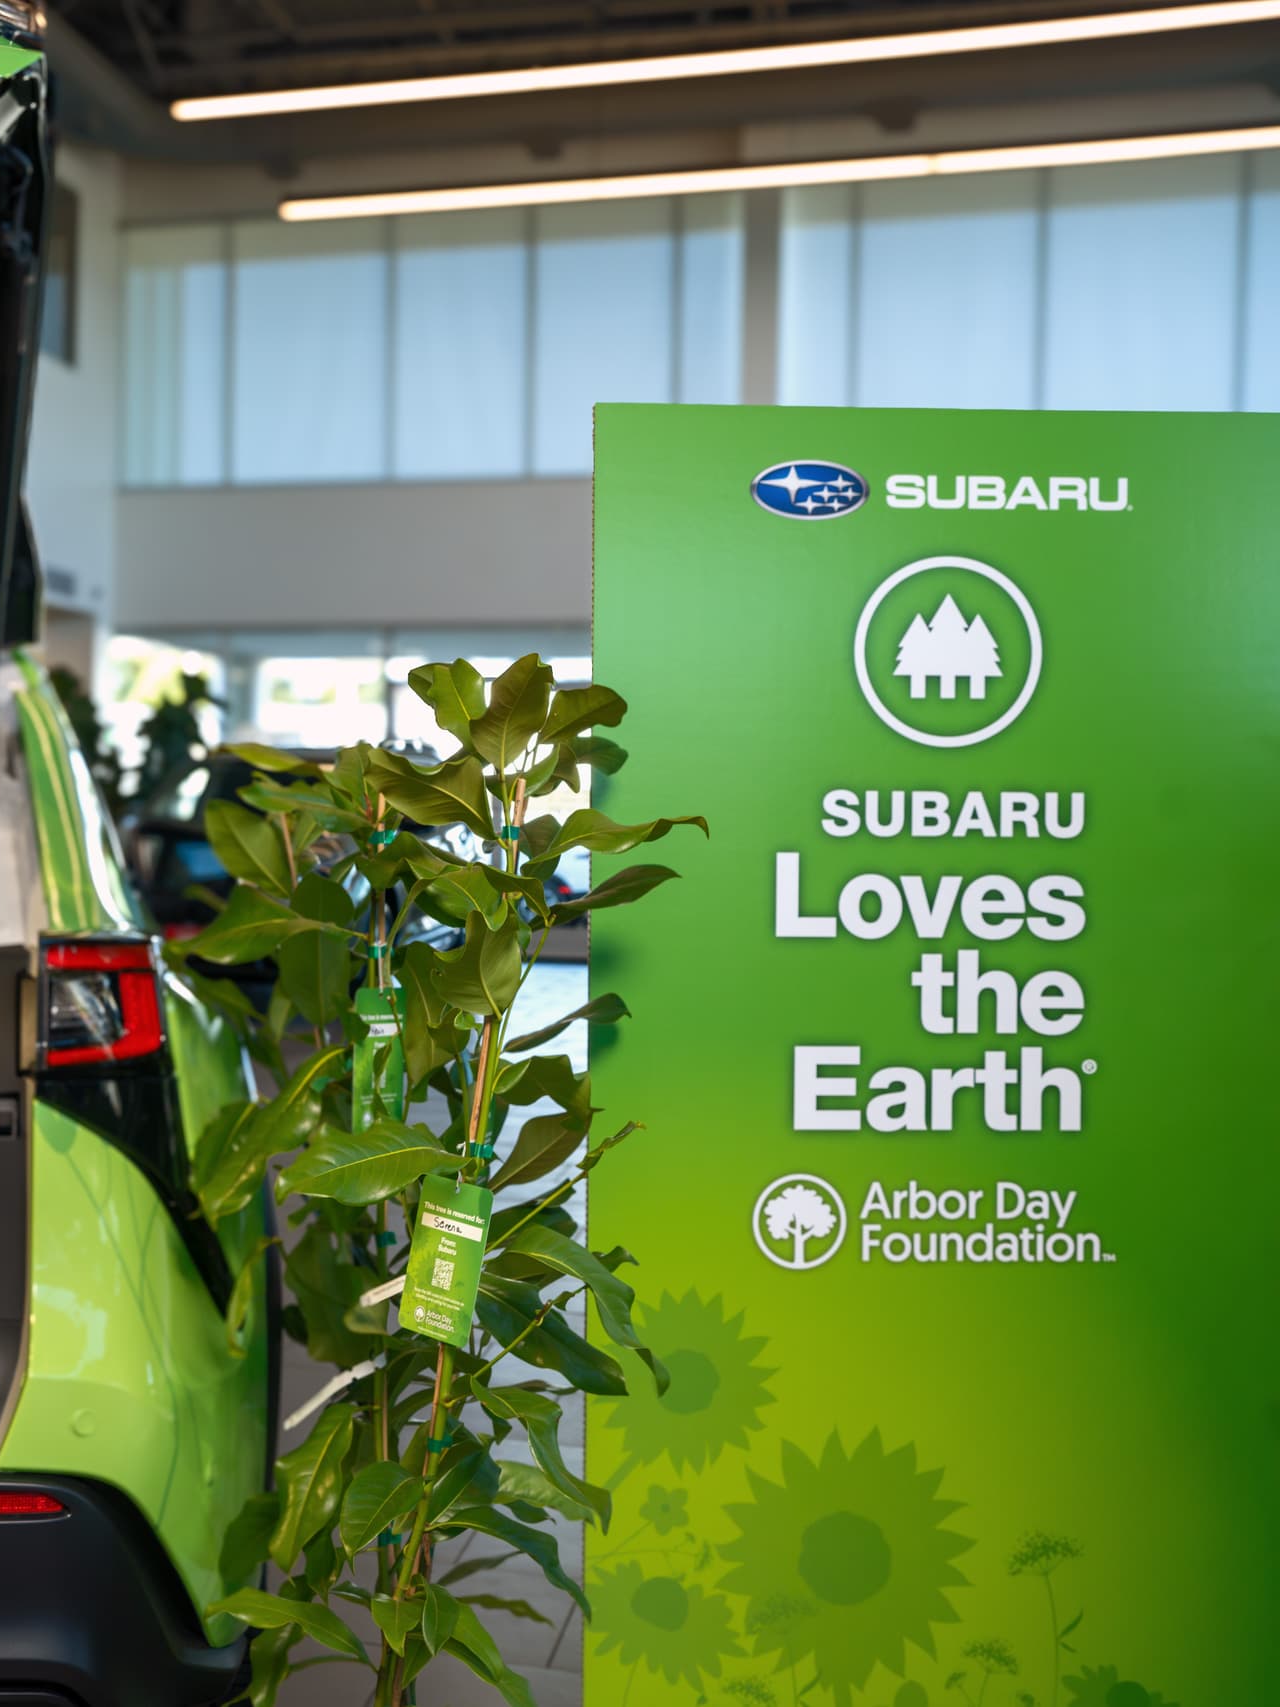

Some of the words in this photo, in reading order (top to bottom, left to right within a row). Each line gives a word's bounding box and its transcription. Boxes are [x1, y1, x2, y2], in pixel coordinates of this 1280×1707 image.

[885, 474, 1129, 512] SUBARU
[821, 789, 1085, 839] SUBARU
[775, 851, 1086, 941] Loves
[911, 949, 1084, 1036] the
[424, 1201, 435, 1211] This
[435, 1204, 446, 1214] tree
[452, 1211, 475, 1222] reserved
[860, 1180, 983, 1220] Arbor
[996, 1182, 1076, 1228] Day
